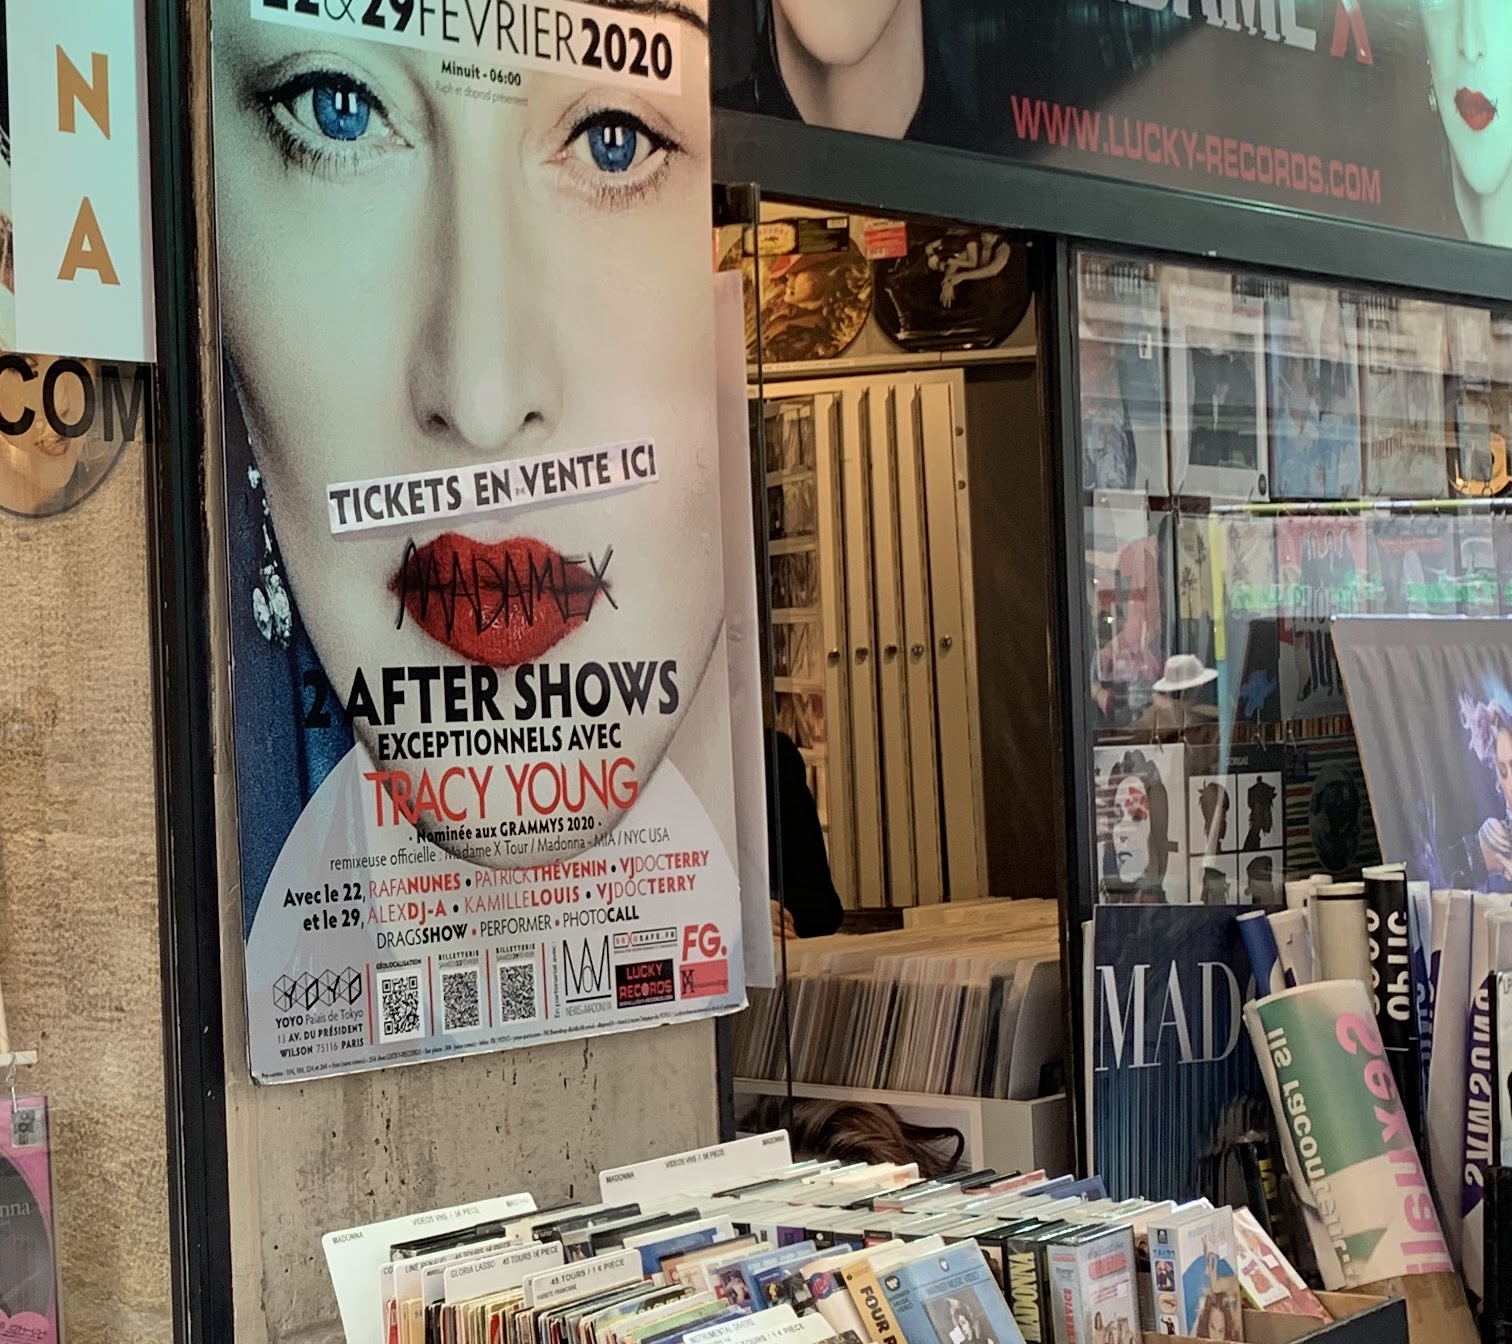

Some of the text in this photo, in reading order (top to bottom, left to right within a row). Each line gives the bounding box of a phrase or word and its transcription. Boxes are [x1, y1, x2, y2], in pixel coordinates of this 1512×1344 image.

[441, 60, 522, 86] Minuit 06:00
[1011, 96, 1381, 204] WWW.LUCKY-RECORDS.COM
[330, 445, 656, 525] TICKETS EN VENTE ICI
[303, 660, 679, 729] 2 AFTER SHOWS
[568, 723, 621, 751] AVEC
[364, 757, 639, 828] TRACY YOUNG
[417, 815, 594, 843] Nominée aux GRAMMYS 2020
[330, 855, 387, 870] remixeuse
[390, 849, 436, 865] officielle
[494, 842, 502, 856] X
[504, 841, 528, 855] Tour
[537, 835, 585, 852] Madonna
[624, 830, 647, 844] NYC
[649, 827, 670, 843] USA
[283, 888, 321, 907] Avec
[324, 884, 338, 903] le
[303, 914, 321, 931] et
[324, 911, 337, 929] le
[480, 915, 552, 937] PERFORMER
[563, 906, 639, 928] PHOTOCALL
[626, 962, 663, 980] LUCKY
[275, 1015, 303, 1028] YOYO
[328, 1010, 338, 1022] de
[341, 1008, 364, 1021] Tokyo
[304, 1029, 316, 1040] DU
[318, 1023, 364, 1038] PRÉSIDENT
[280, 1046, 313, 1058] WILSON
[341, 1038, 364, 1050] PARIS
[606, 1171, 635, 1184] MADONNA
[332, 1231, 364, 1244] MADONNA
[412, 1213, 434, 1226] VIDEOS
[461, 1207, 481, 1218] PIECE
[450, 1264, 473, 1278] GLORIA
[475, 1260, 496, 1274] LASSO
[502, 1257, 510, 1266] 45
[510, 1252, 533, 1264] TOURS
[540, 1244, 559, 1256] PIECE
[550, 1259, 625, 1286] 45 TOURS PIECE
[860, 1285, 890, 1334] FOUR
[1009, 1252, 1041, 1343] MADONNA
[783, 1323, 805, 1336] PIECE
